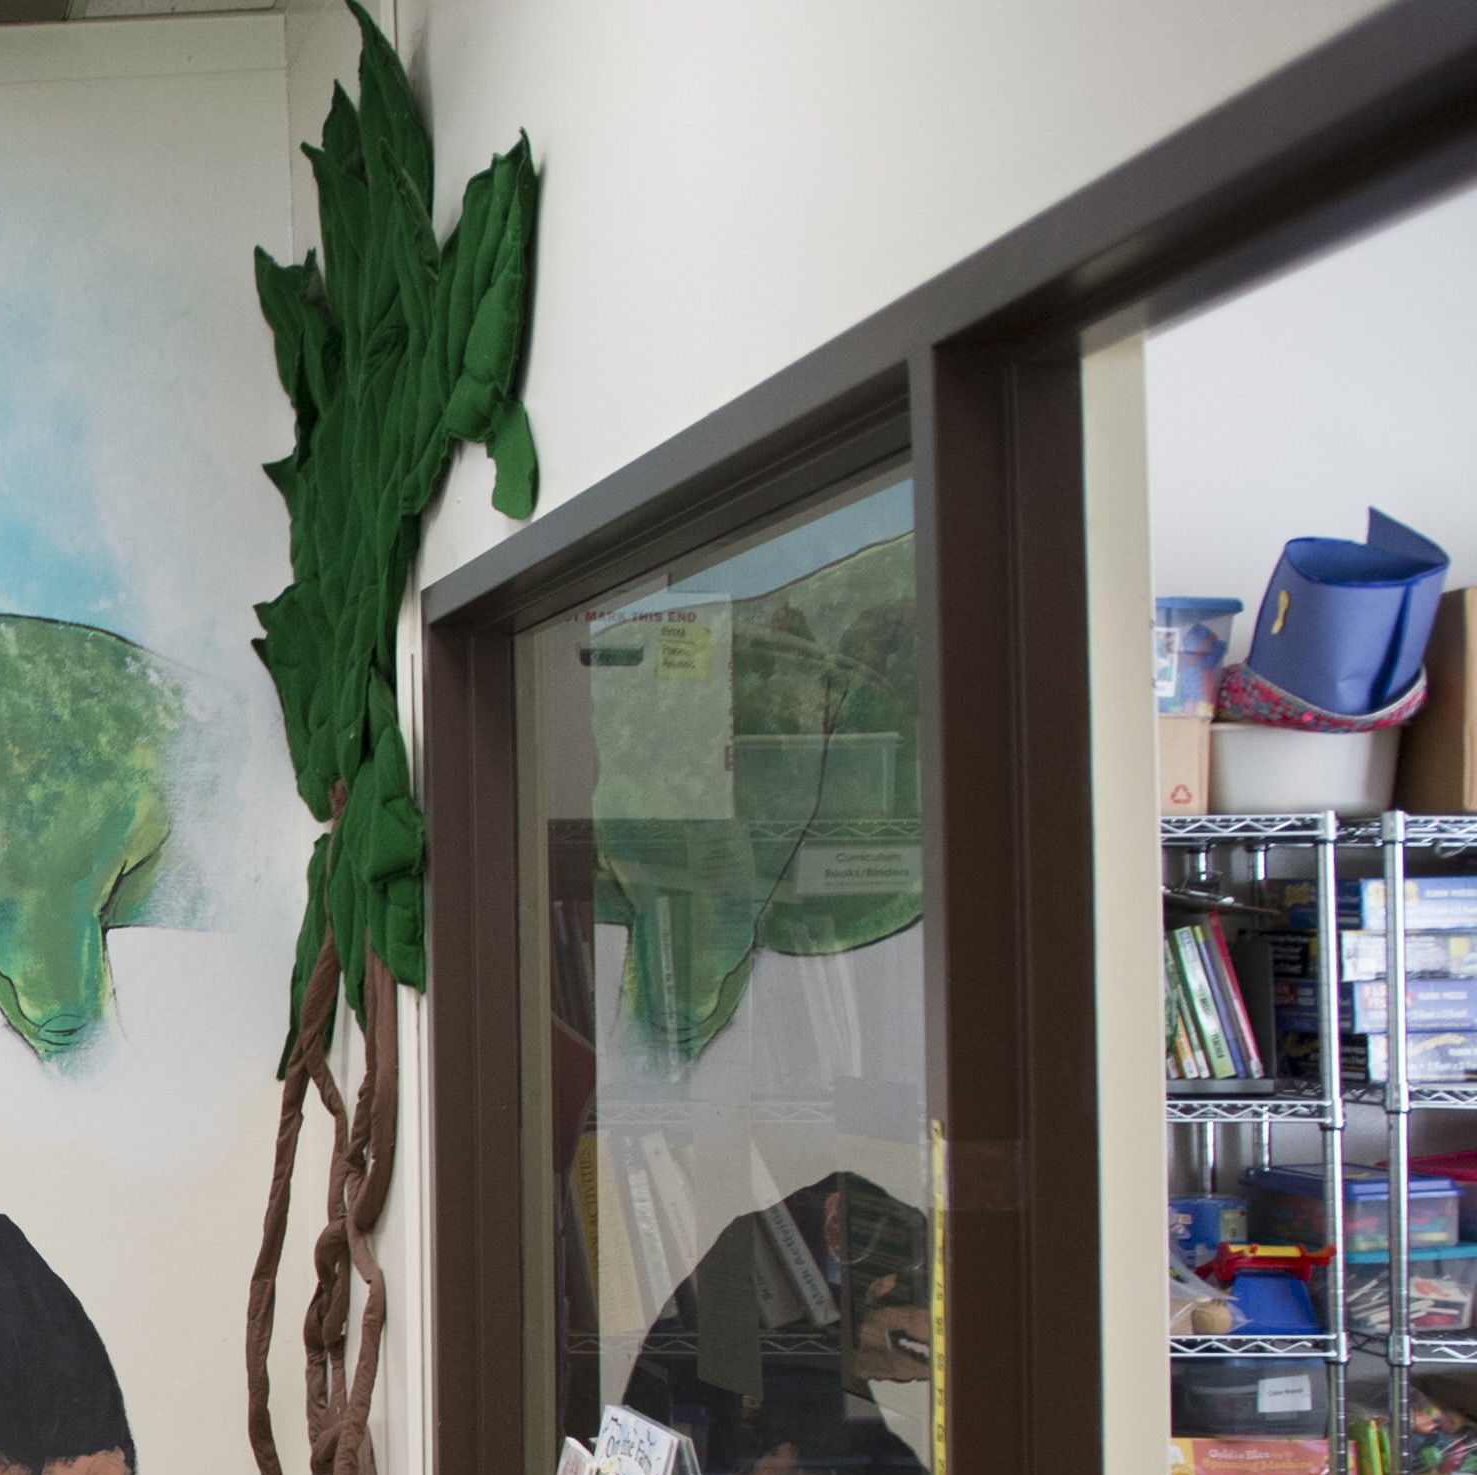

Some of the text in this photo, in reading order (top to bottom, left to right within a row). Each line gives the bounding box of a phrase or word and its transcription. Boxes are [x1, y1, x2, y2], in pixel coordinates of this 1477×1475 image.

[632, 611, 663, 623] THIS
[668, 611, 697, 623] END
[836, 852, 902, 863] Curriculum
[824, 867, 910, 878] Books/Binders
[770, 1207, 805, 1265] Activitie
